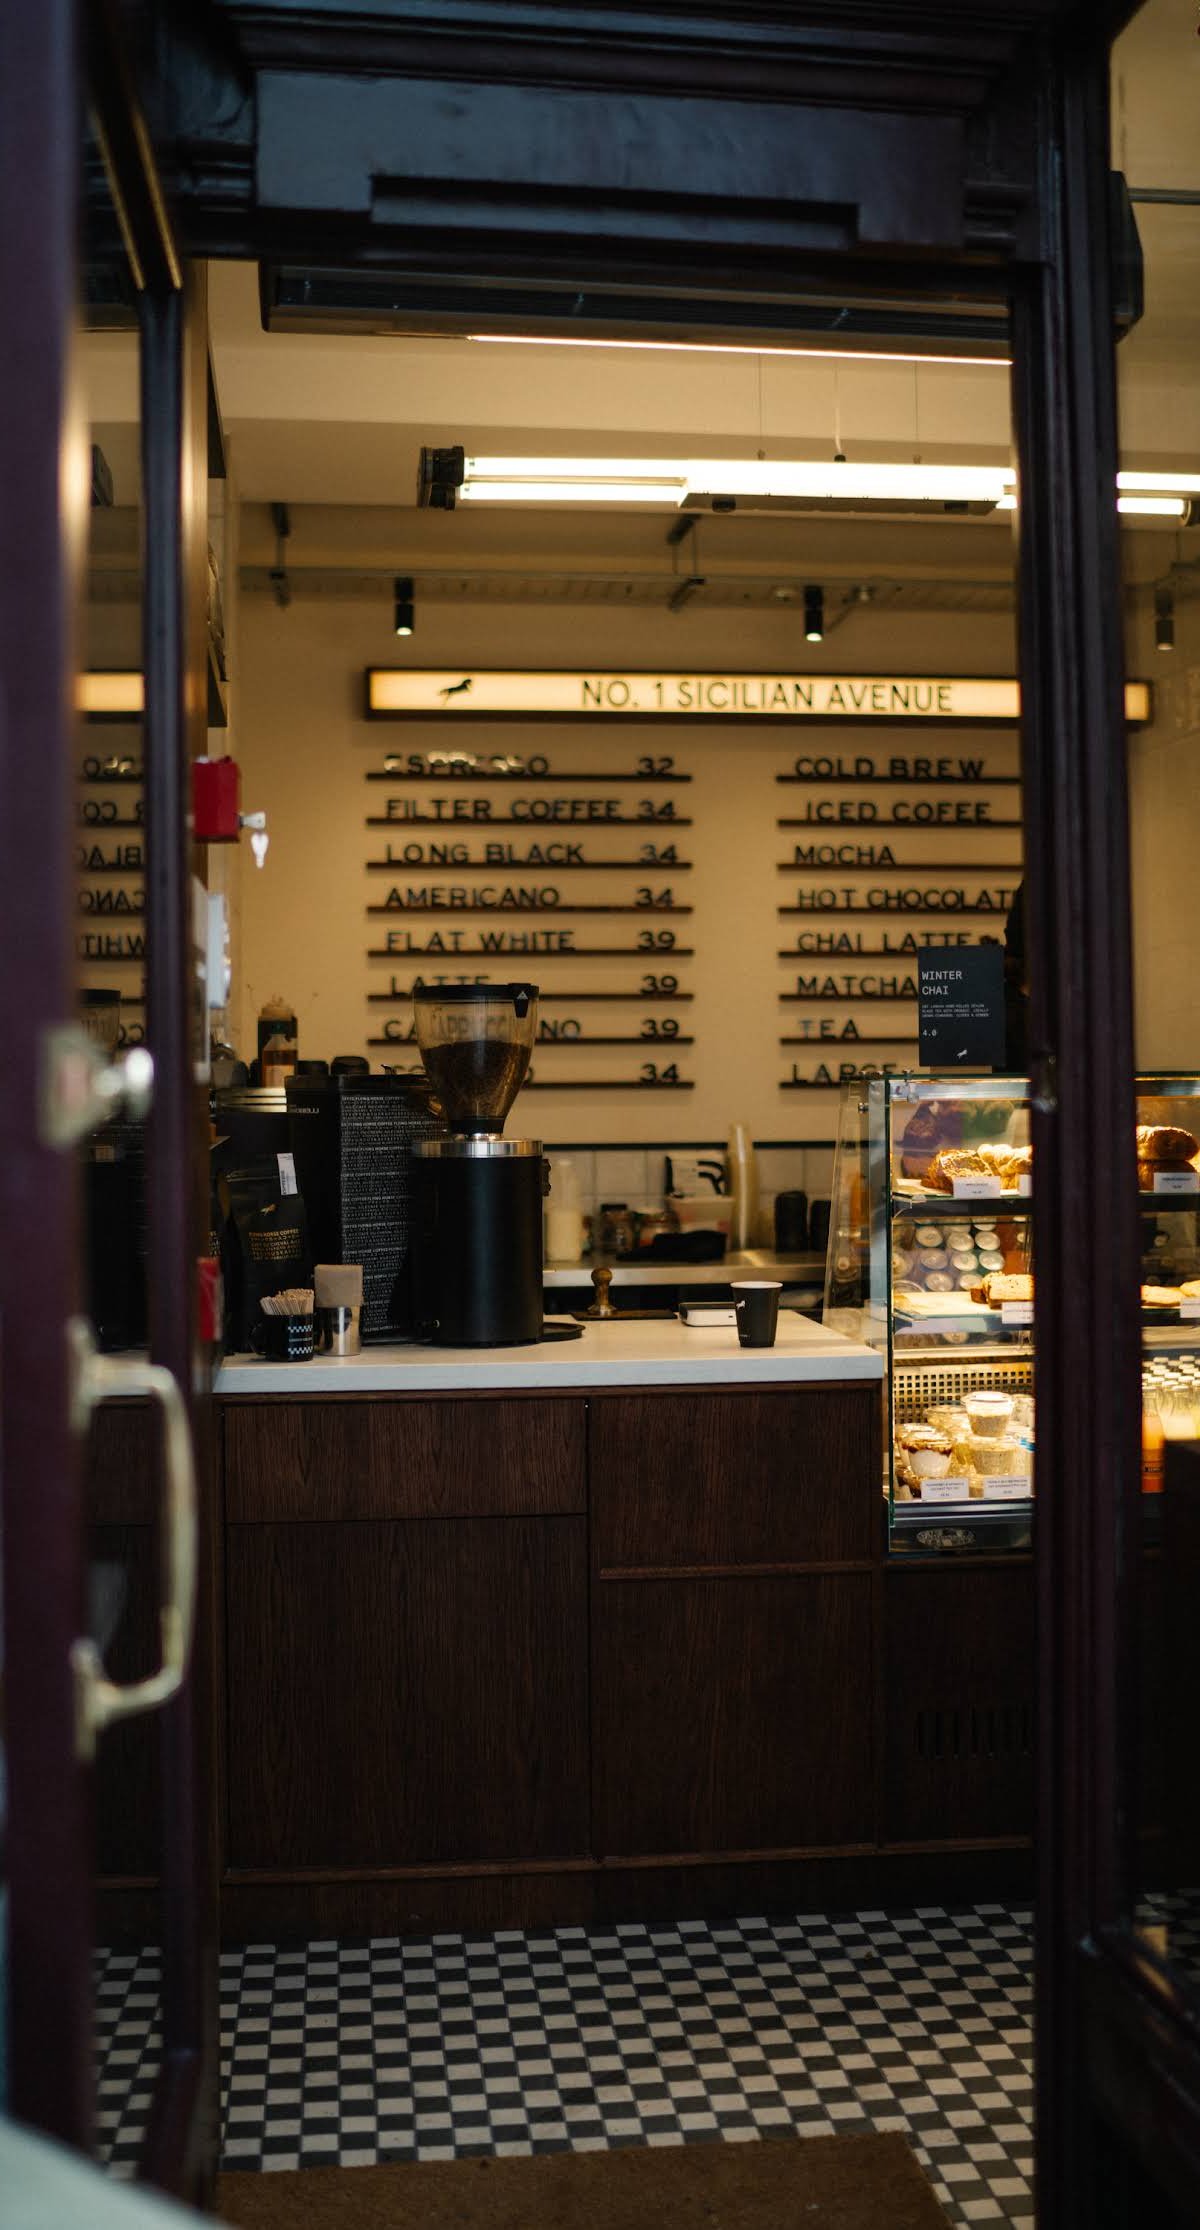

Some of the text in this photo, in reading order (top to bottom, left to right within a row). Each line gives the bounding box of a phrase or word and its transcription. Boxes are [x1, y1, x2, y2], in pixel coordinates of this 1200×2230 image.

[583, 680, 953, 712] NO. 1 SICILIAN AVENUE
[637, 757, 674, 776] 32
[795, 758, 985, 779] COLD BREW
[387, 799, 676, 821] FILTER COFFEE 34
[806, 800, 878, 822] ICED
[386, 844, 677, 865] LONG BLACK 34
[795, 845, 897, 866] MOCHA
[385, 887, 674, 908] AMERICANO 34
[797, 888, 856, 909] HOT
[387, 932, 676, 952] FLAT WHITE 39
[797, 932, 971, 953] CHAI LATTE
[921, 970, 962, 980] WINTER
[640, 976, 679, 996] 39
[797, 976, 918, 997] MATCHA
[921, 985, 949, 996] CHAI
[640, 1019, 680, 1040] 39
[799, 1019, 861, 1040] TEA
[922, 1029, 937, 1037] 4.0
[639, 1064, 680, 1084] 34
